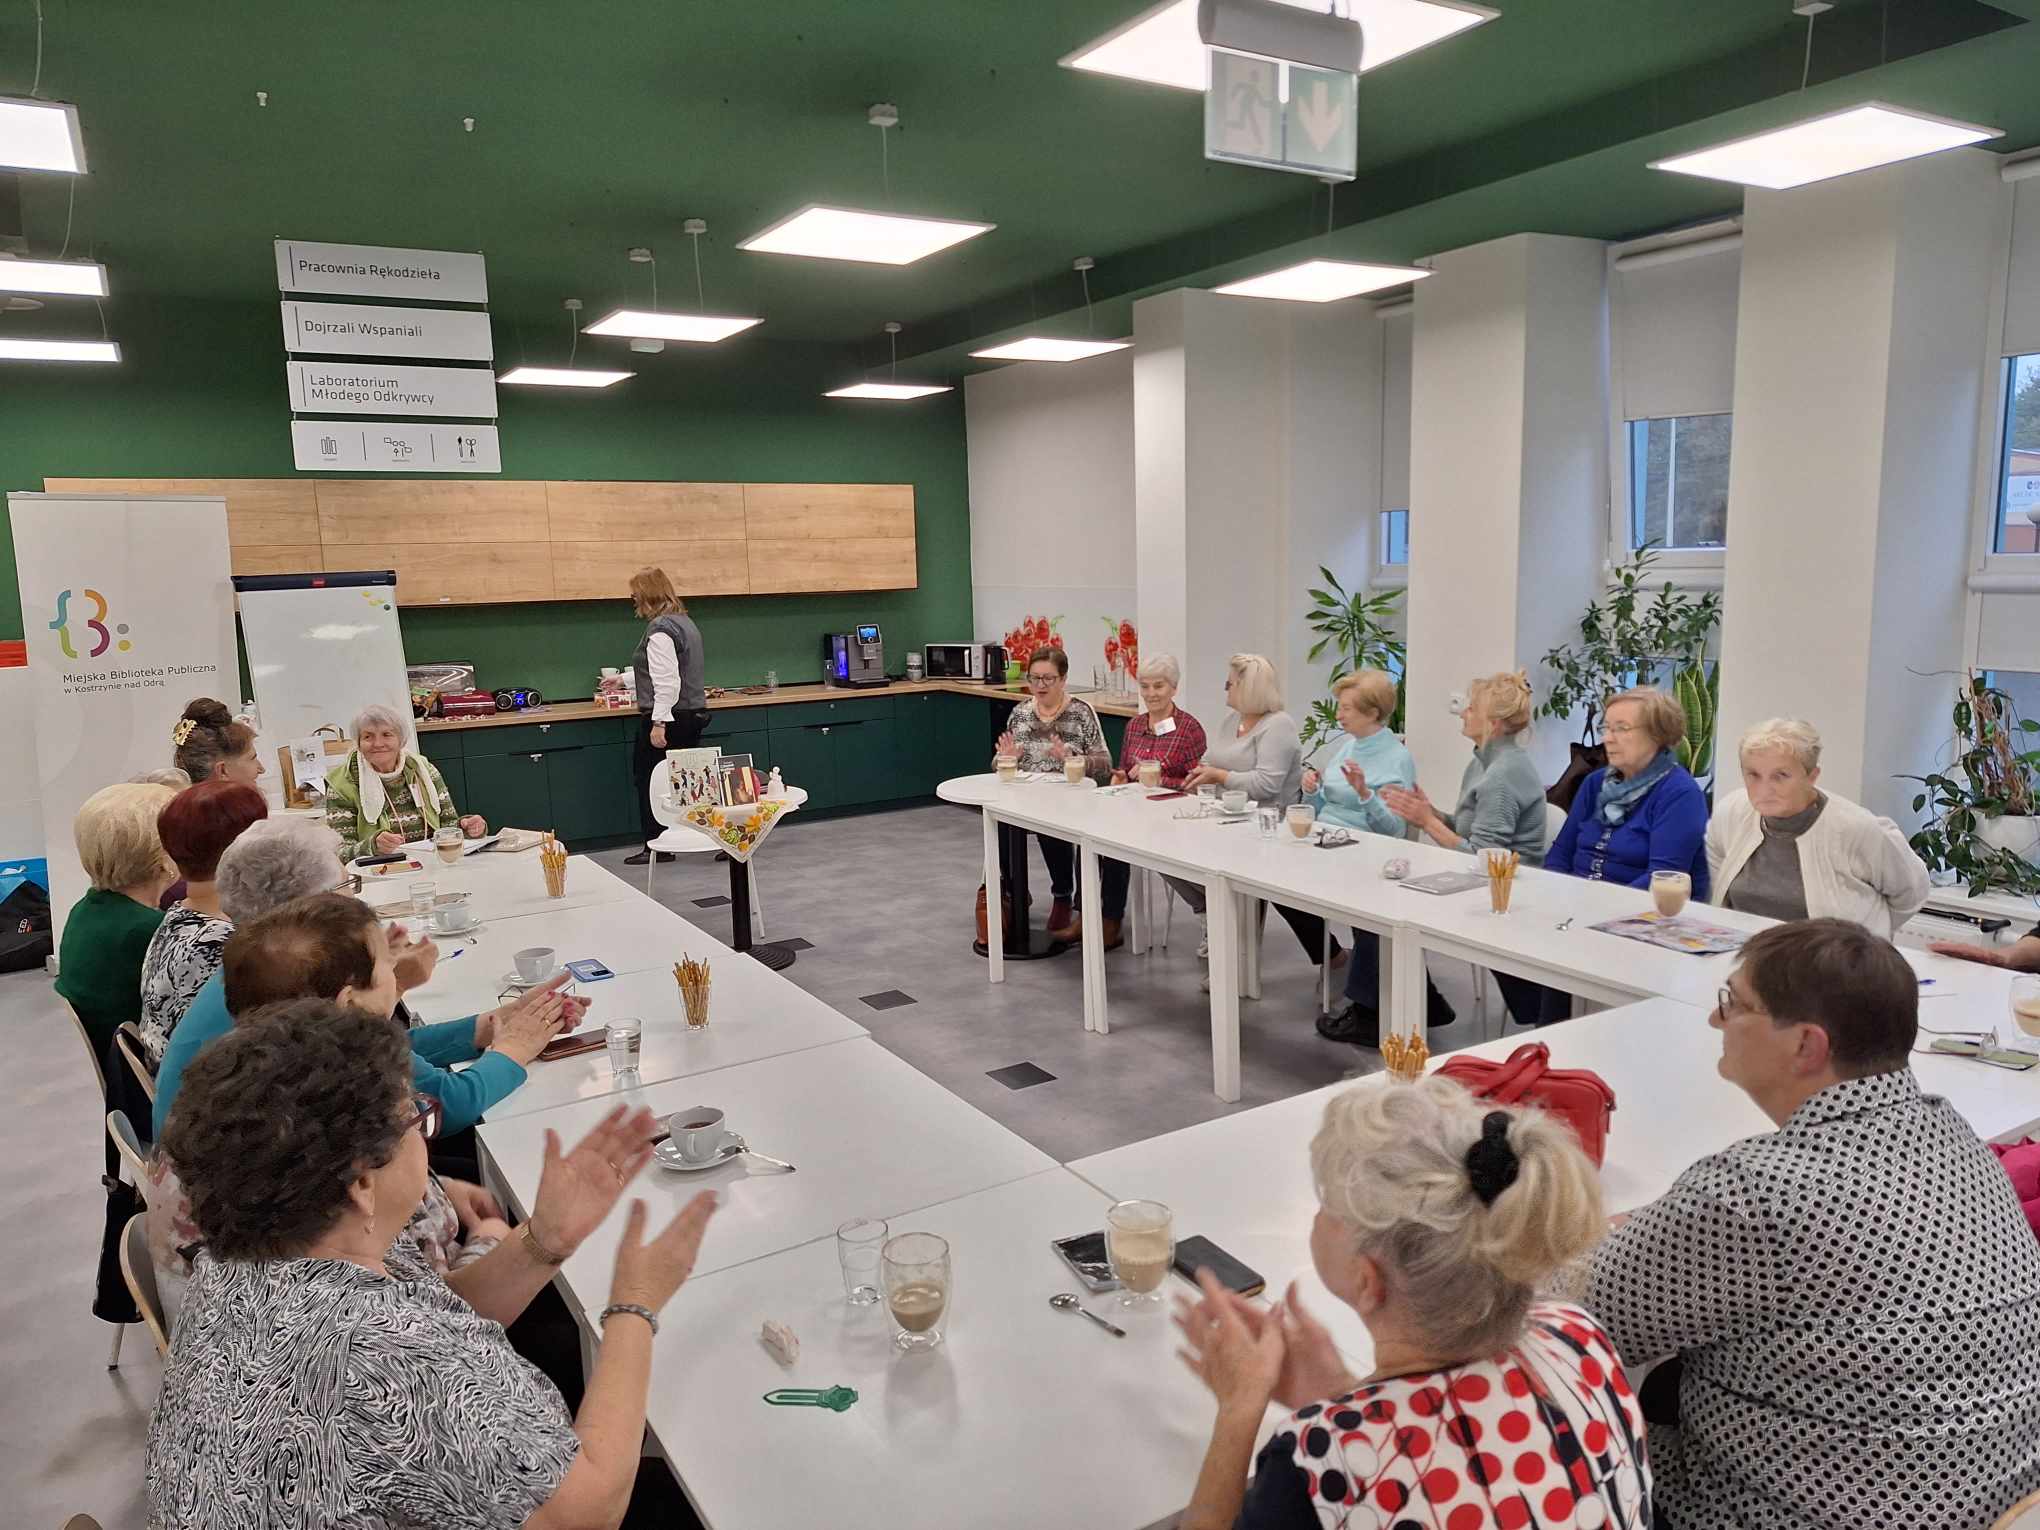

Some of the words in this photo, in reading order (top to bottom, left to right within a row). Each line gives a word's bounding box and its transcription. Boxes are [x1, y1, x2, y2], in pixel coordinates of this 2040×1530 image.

[299, 260, 366, 276] Pracownia
[369, 264, 441, 281] Rękodzieła
[304, 320, 355, 336] Dojrzali
[358, 323, 423, 338] Wspaniali
[309, 374, 399, 388] Laboratorium
[311, 388, 370, 403] Młodego
[373, 390, 435, 405] Odkrywcy
[63, 672, 107, 685] Miejska
[110, 667, 164, 681] Biblioteka
[167, 663, 217, 676] Publiczna
[74, 683, 122, 694] Kostrzynie
[124, 680, 141, 689] nad
[143, 679, 165, 688] Odrą
